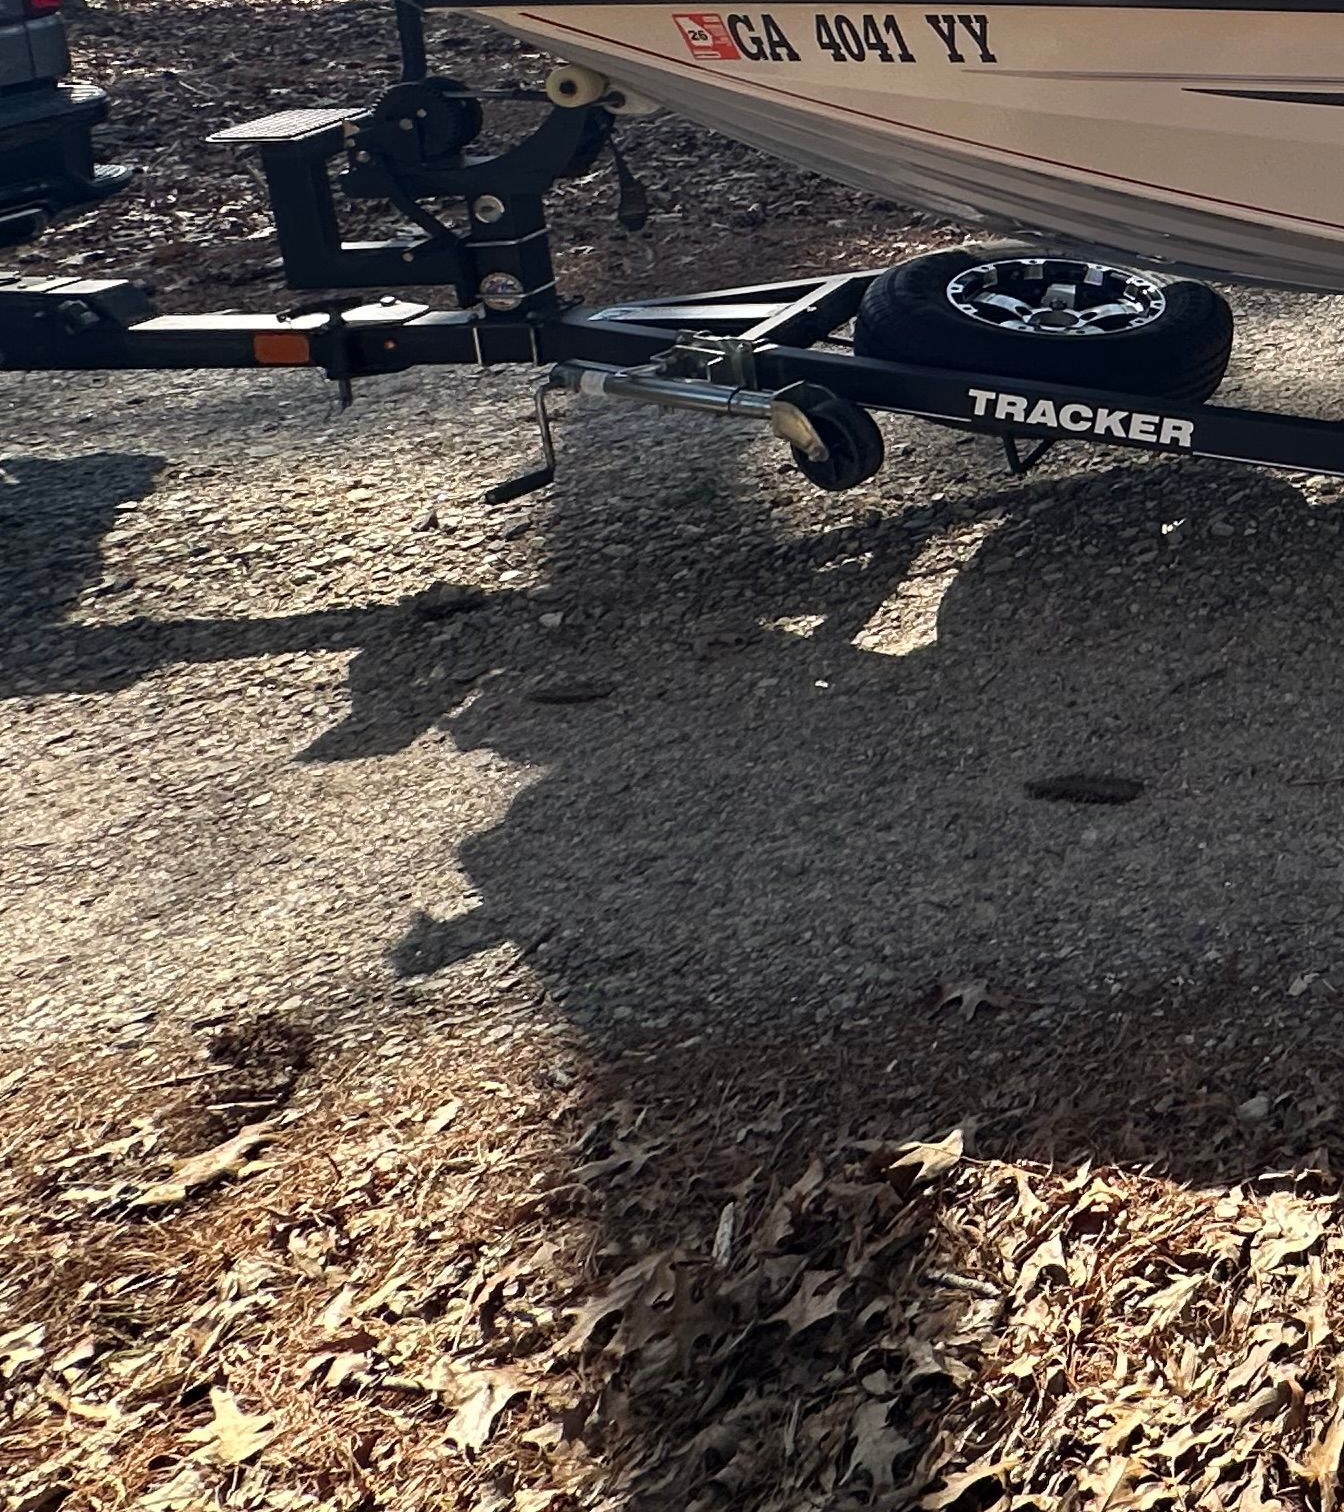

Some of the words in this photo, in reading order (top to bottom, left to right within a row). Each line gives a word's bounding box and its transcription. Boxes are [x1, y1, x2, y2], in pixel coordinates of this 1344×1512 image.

[727, 14, 801, 61] GA
[815, 14, 916, 62] 4041
[925, 14, 998, 63] YY
[968, 389, 1194, 447] TRACKER
